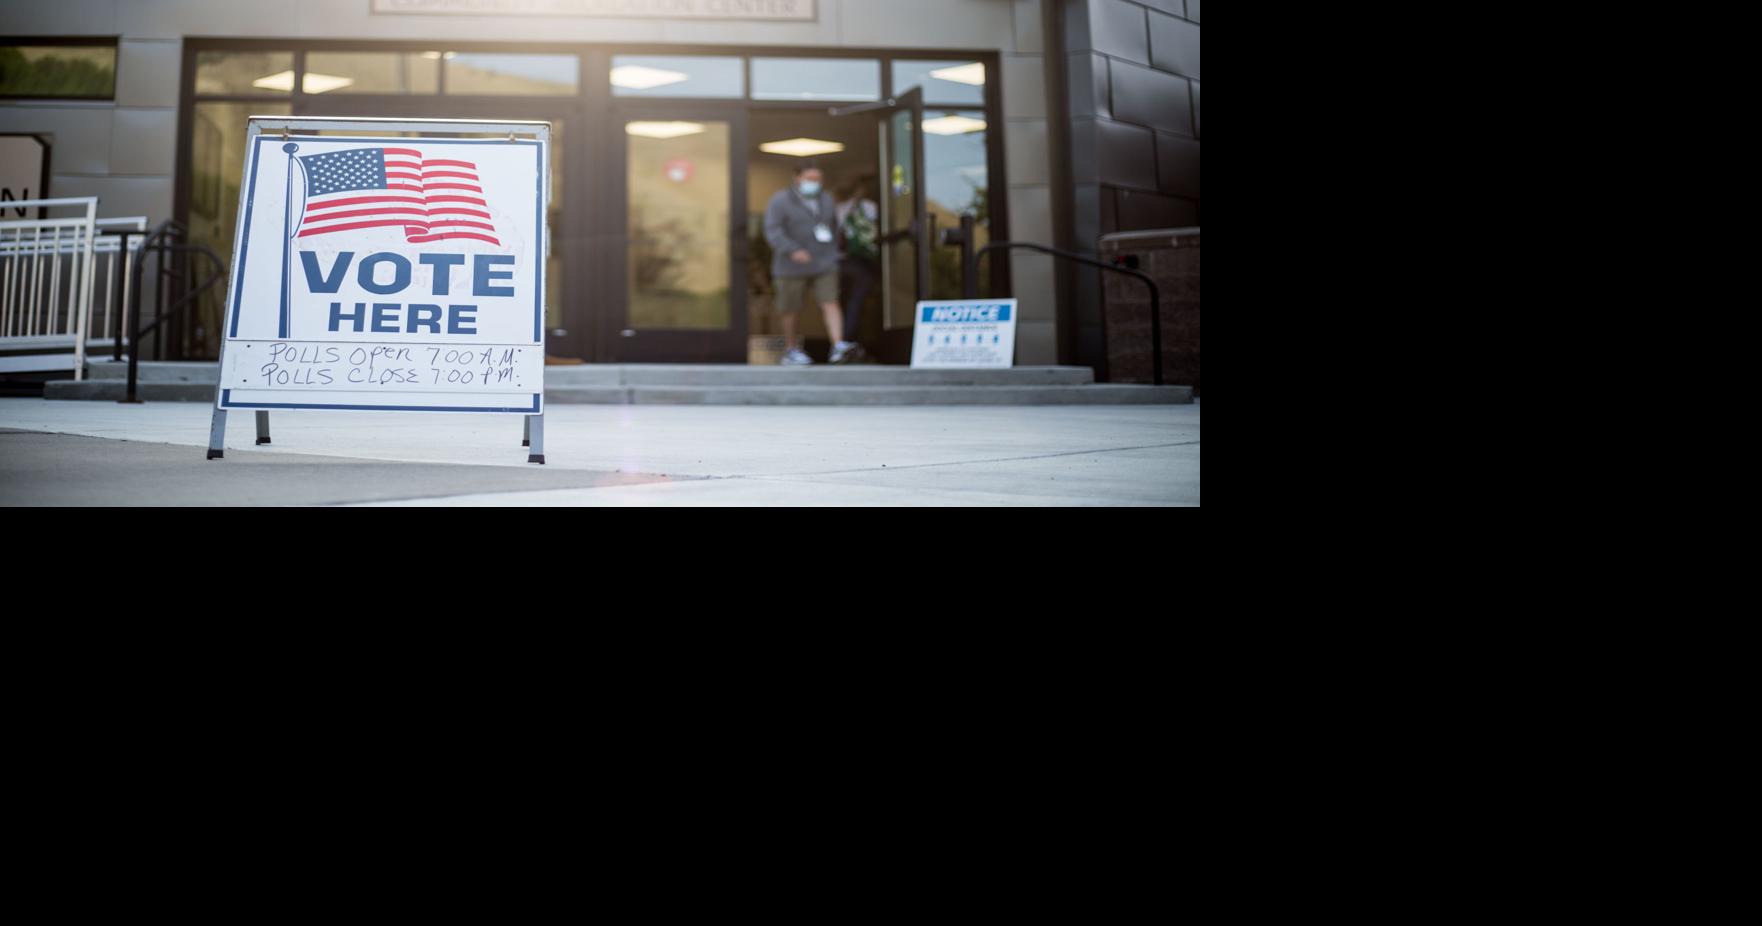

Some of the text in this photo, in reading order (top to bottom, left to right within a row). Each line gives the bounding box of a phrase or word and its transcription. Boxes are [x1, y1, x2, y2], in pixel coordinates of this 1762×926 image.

[300, 251, 516, 298] VOTE
[327, 302, 478, 335] HERE
[930, 305, 999, 321] NOTICE
[269, 342, 340, 363] POLLS
[261, 363, 334, 387] POLLS
[347, 367, 419, 385] CLOSE
[431, 368, 474, 384] 7:00
